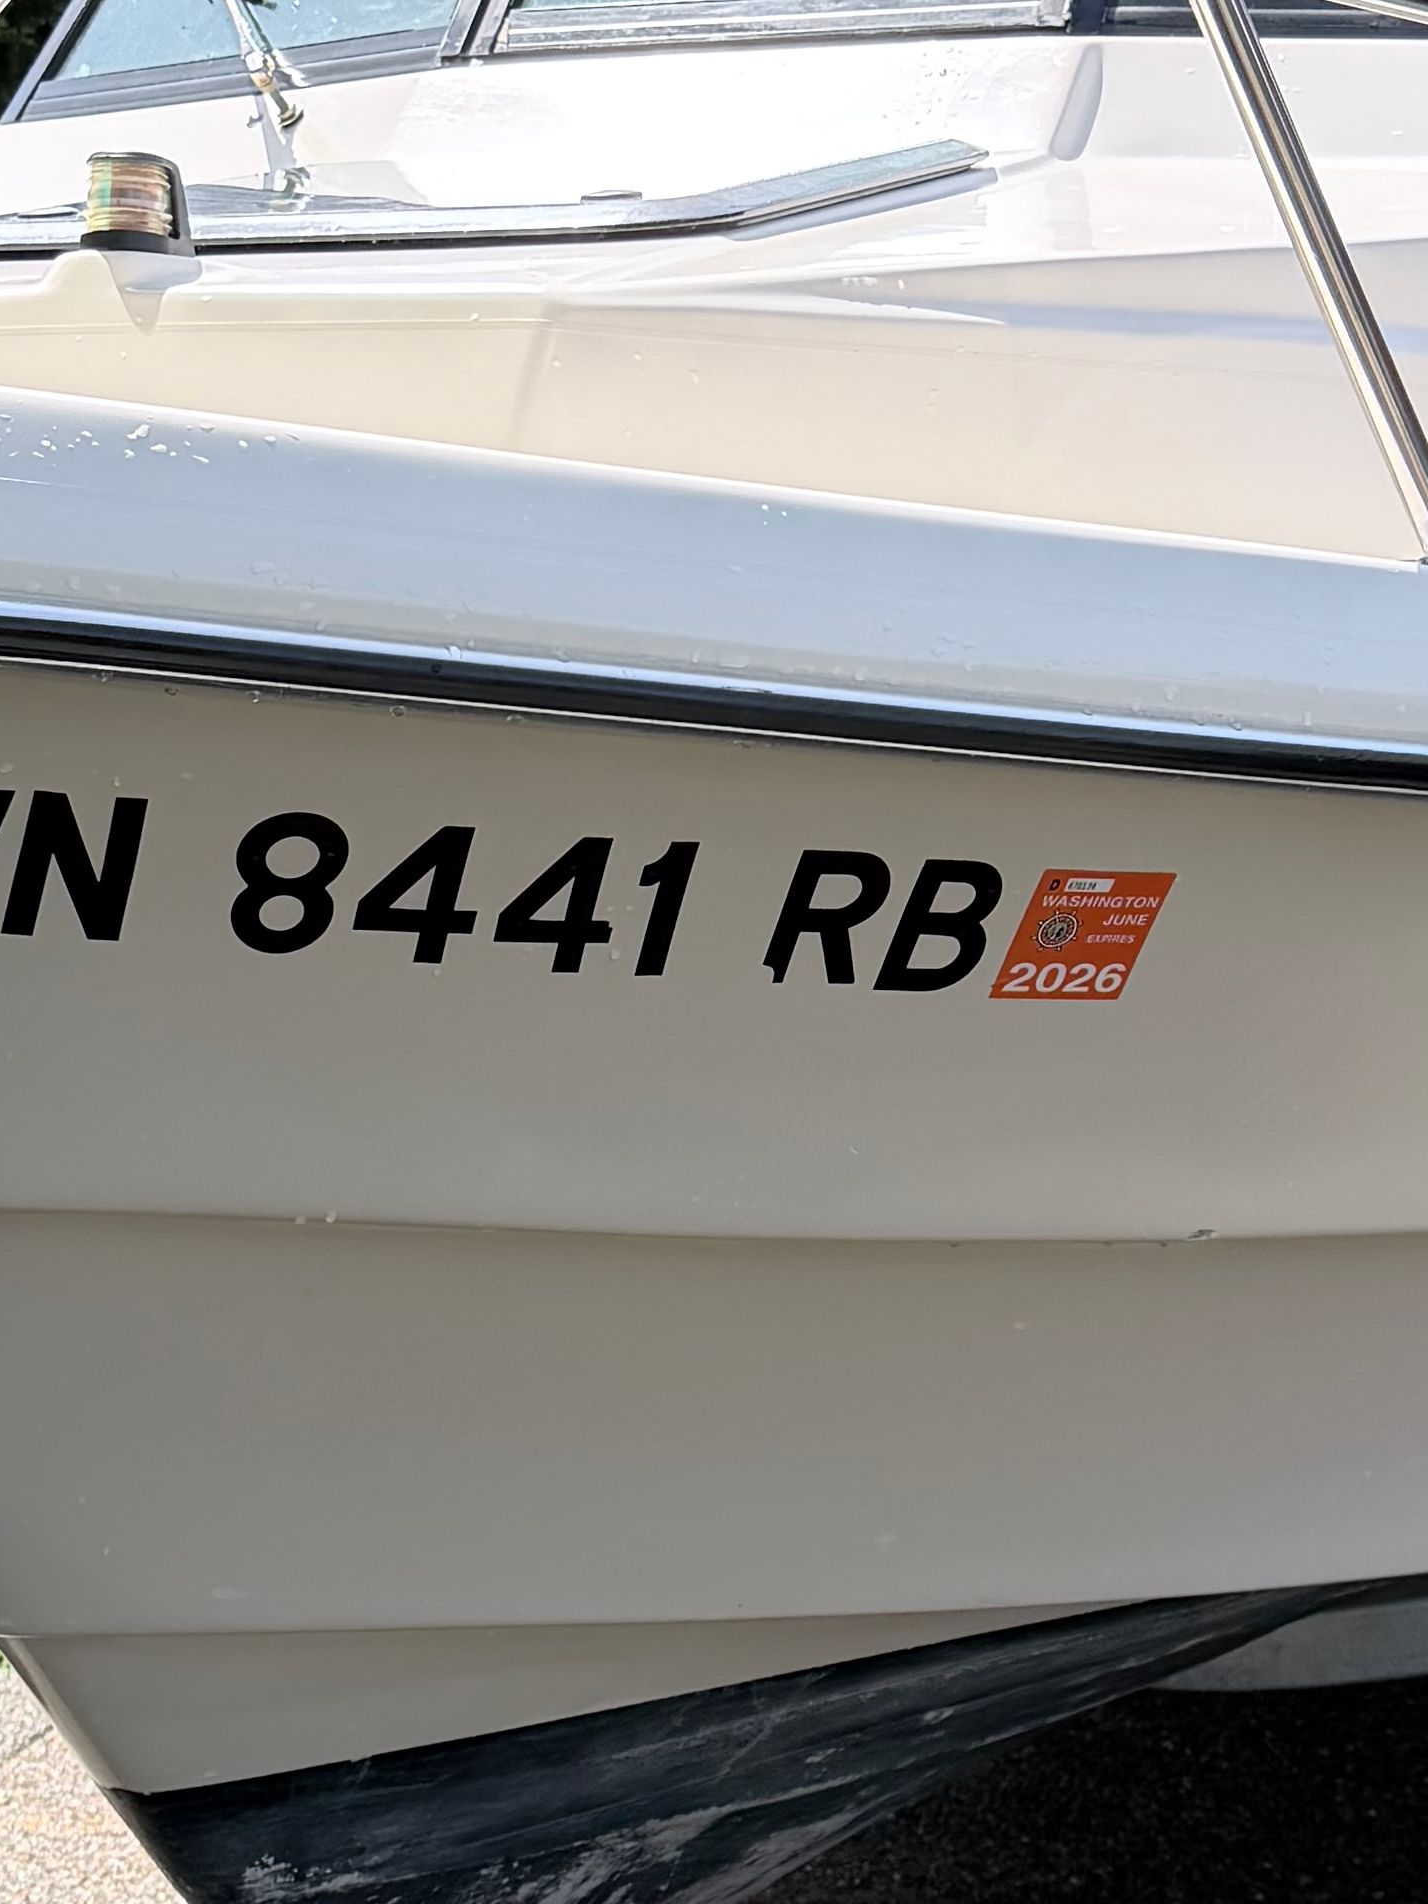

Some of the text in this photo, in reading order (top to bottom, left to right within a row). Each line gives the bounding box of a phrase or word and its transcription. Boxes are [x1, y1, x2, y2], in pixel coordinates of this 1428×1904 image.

[230, 811, 700, 977] 8441
[762, 849, 1003, 992] RB
[1042, 895, 1160, 909] WASHINGTON
[1103, 914, 1150, 927] JUNE
[1086, 934, 1136, 945] EXPIRES
[1001, 962, 1127, 994] 2026
